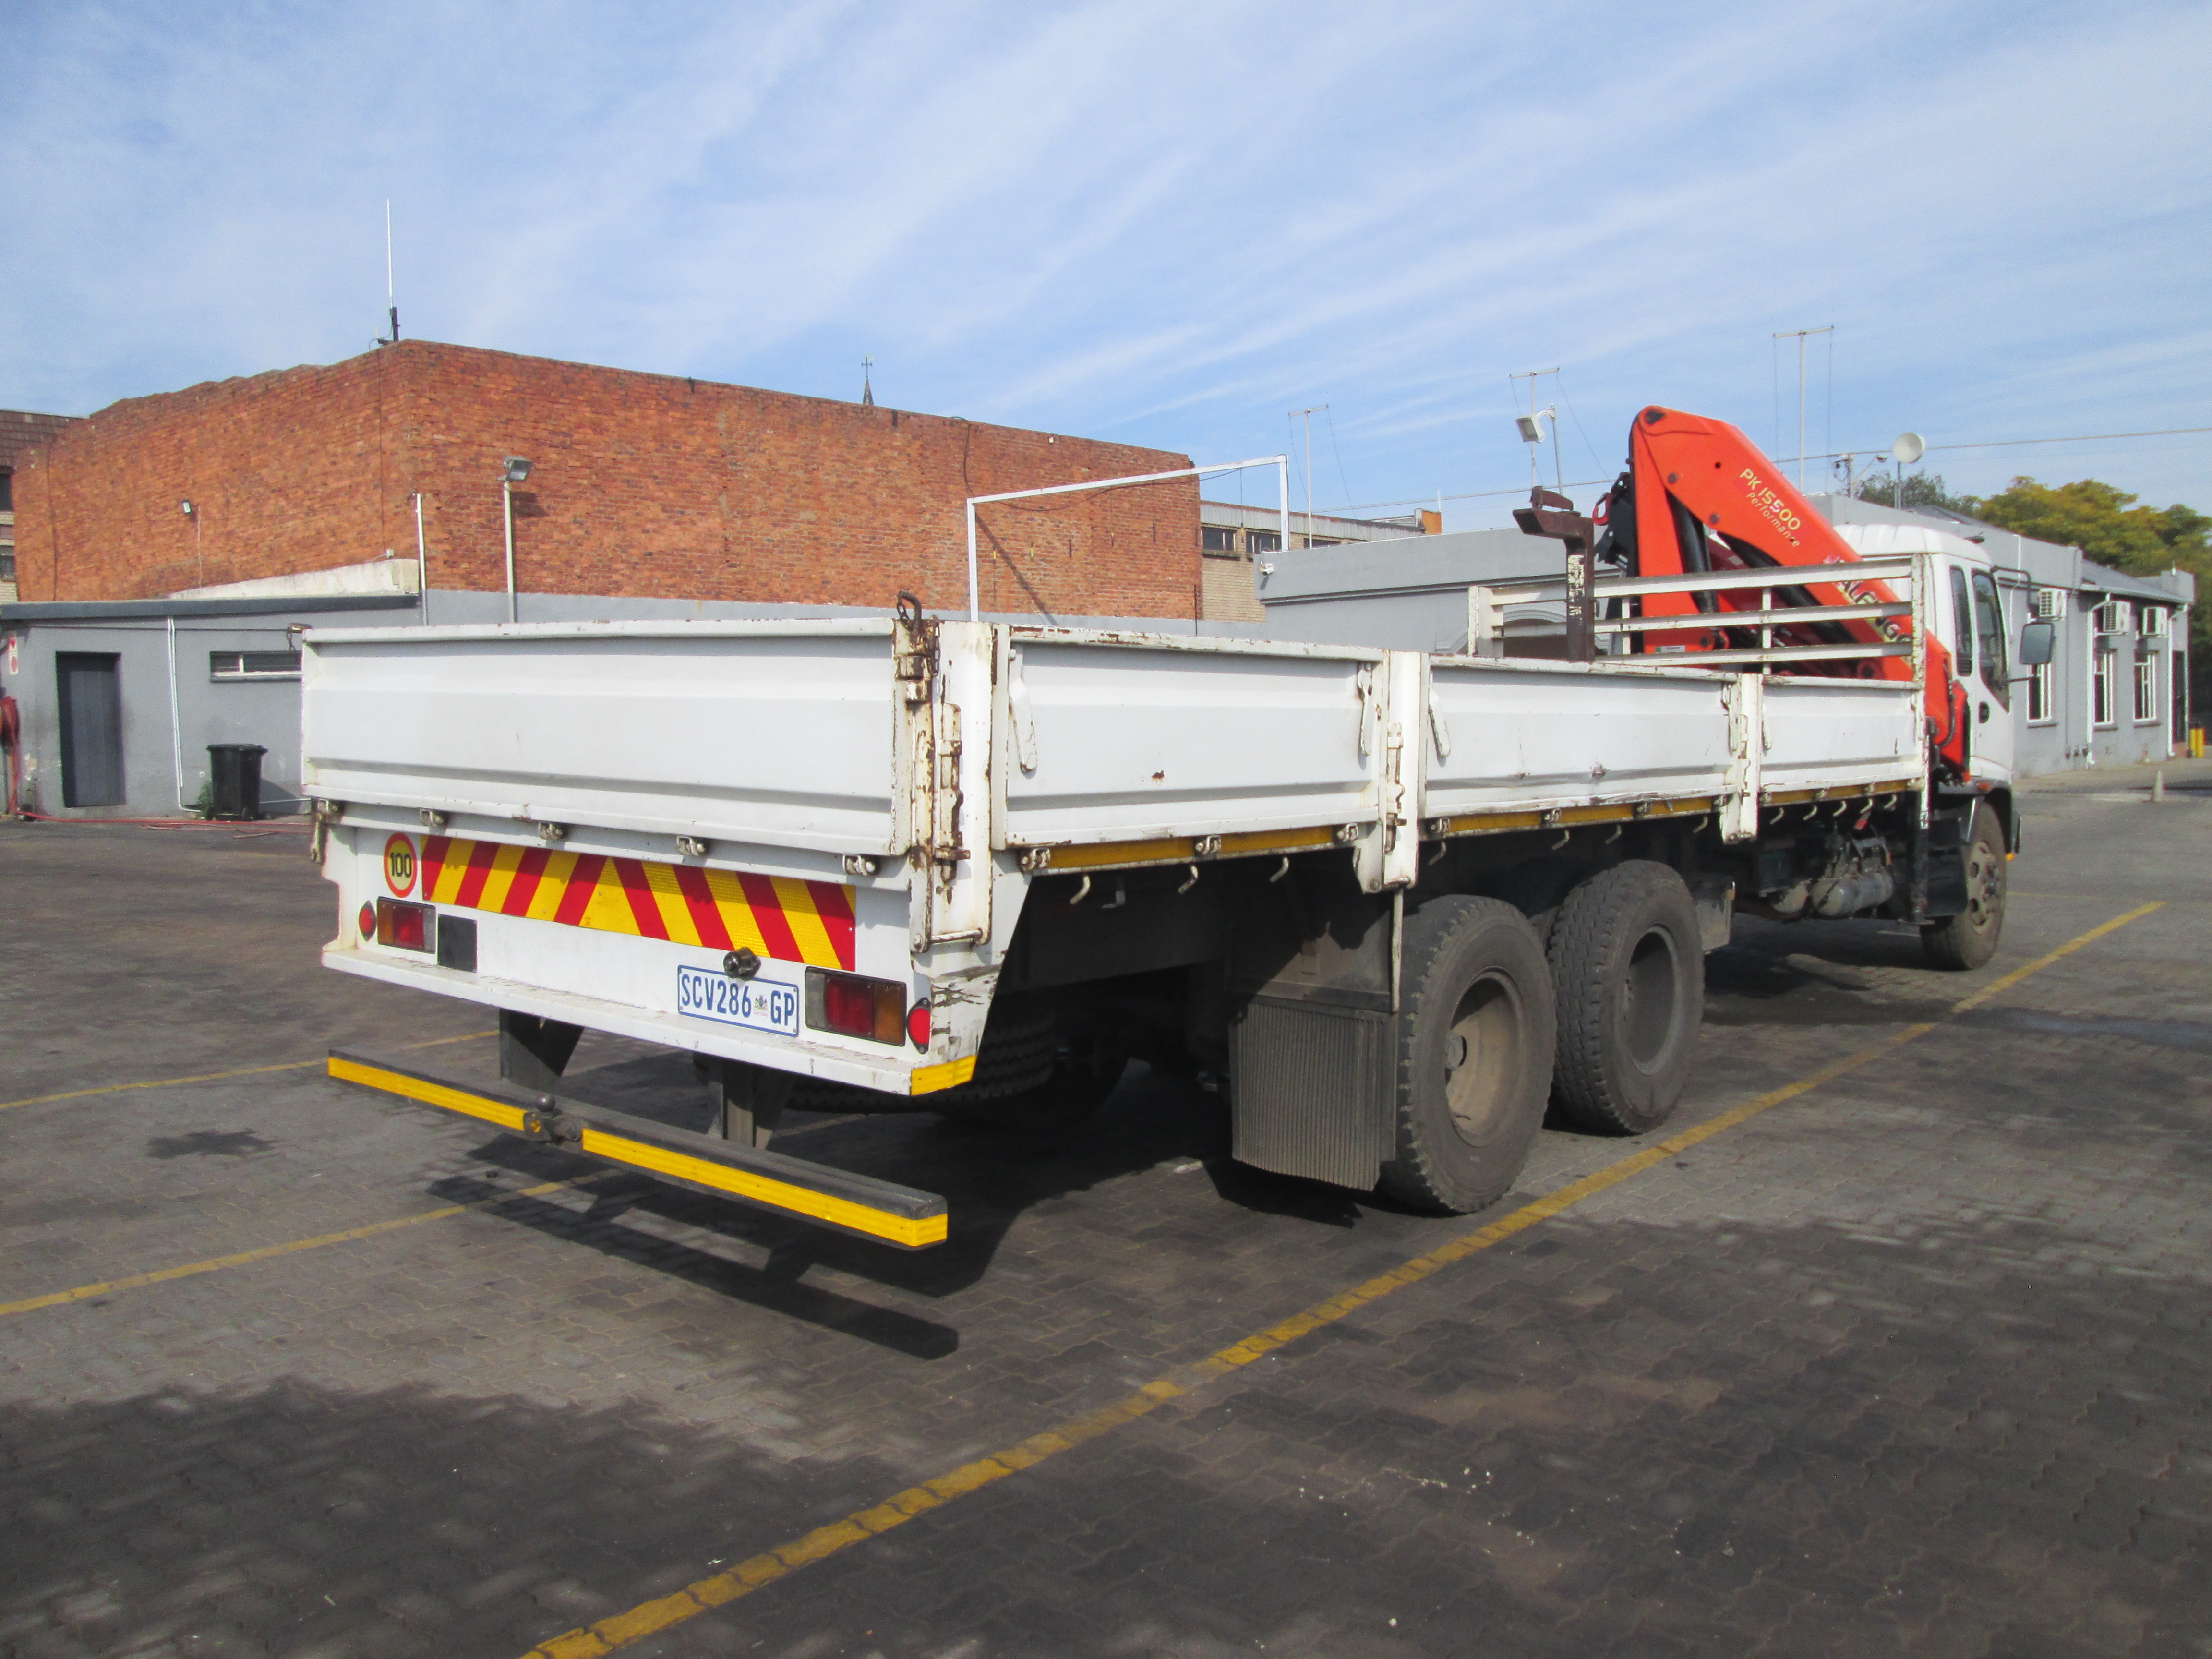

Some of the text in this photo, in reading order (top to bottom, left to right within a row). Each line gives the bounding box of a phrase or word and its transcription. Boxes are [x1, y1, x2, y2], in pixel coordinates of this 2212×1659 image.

[1740, 468, 1801, 530] PK 15500
[390, 852, 412, 878] 100
[681, 974, 795, 1026] SCV286 GP
